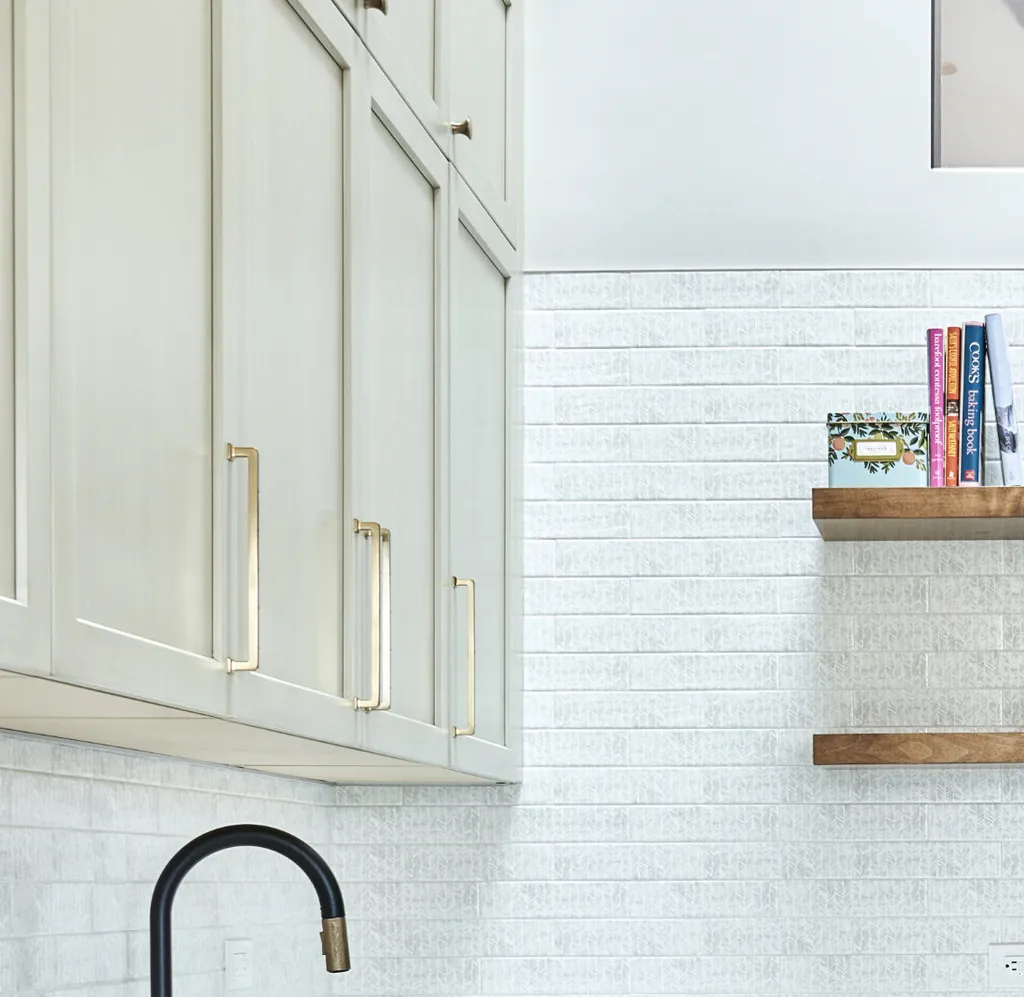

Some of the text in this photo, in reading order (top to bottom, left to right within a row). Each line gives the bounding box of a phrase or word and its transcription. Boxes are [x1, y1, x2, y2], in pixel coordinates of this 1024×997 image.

[932, 333, 942, 446] barefoot contessa foolproof
[964, 390, 978, 426] baking
[966, 428, 978, 455] book
